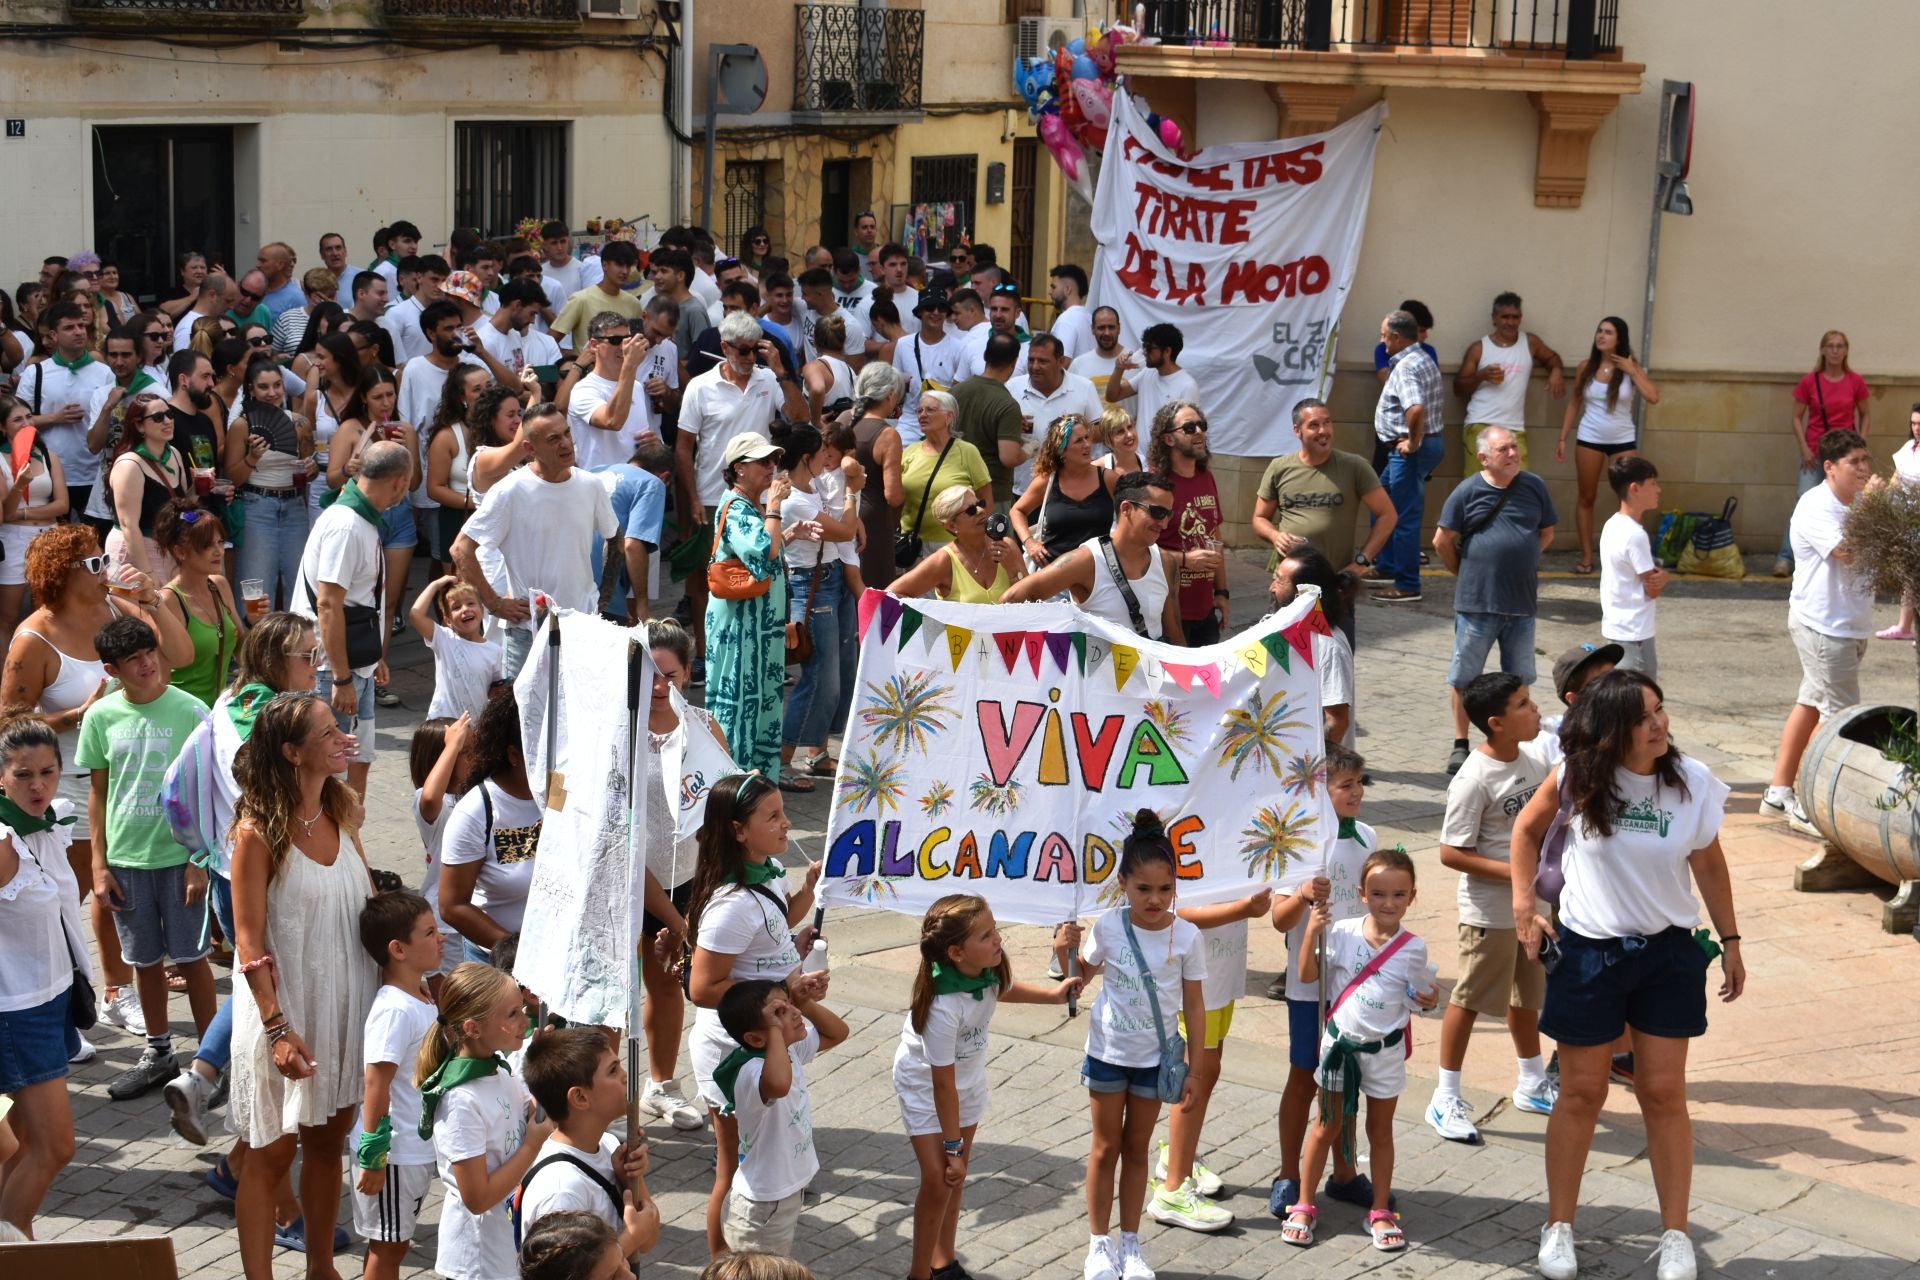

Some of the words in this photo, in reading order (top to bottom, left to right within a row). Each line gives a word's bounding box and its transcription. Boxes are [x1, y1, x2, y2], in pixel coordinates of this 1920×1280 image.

[11, 121, 21, 135] 12
[1116, 231, 1160, 299] DE
[1163, 256, 1206, 306] LA
[1220, 255, 1330, 305] MOTO
[1273, 322, 1299, 345] EL
[951, 634, 1067, 663] BANDA
[1090, 645, 1158, 679] DEL
[825, 815, 1204, 884] ALCANADE
[1333, 884, 1360, 904] BAN
[1356, 945, 1372, 958] LA
